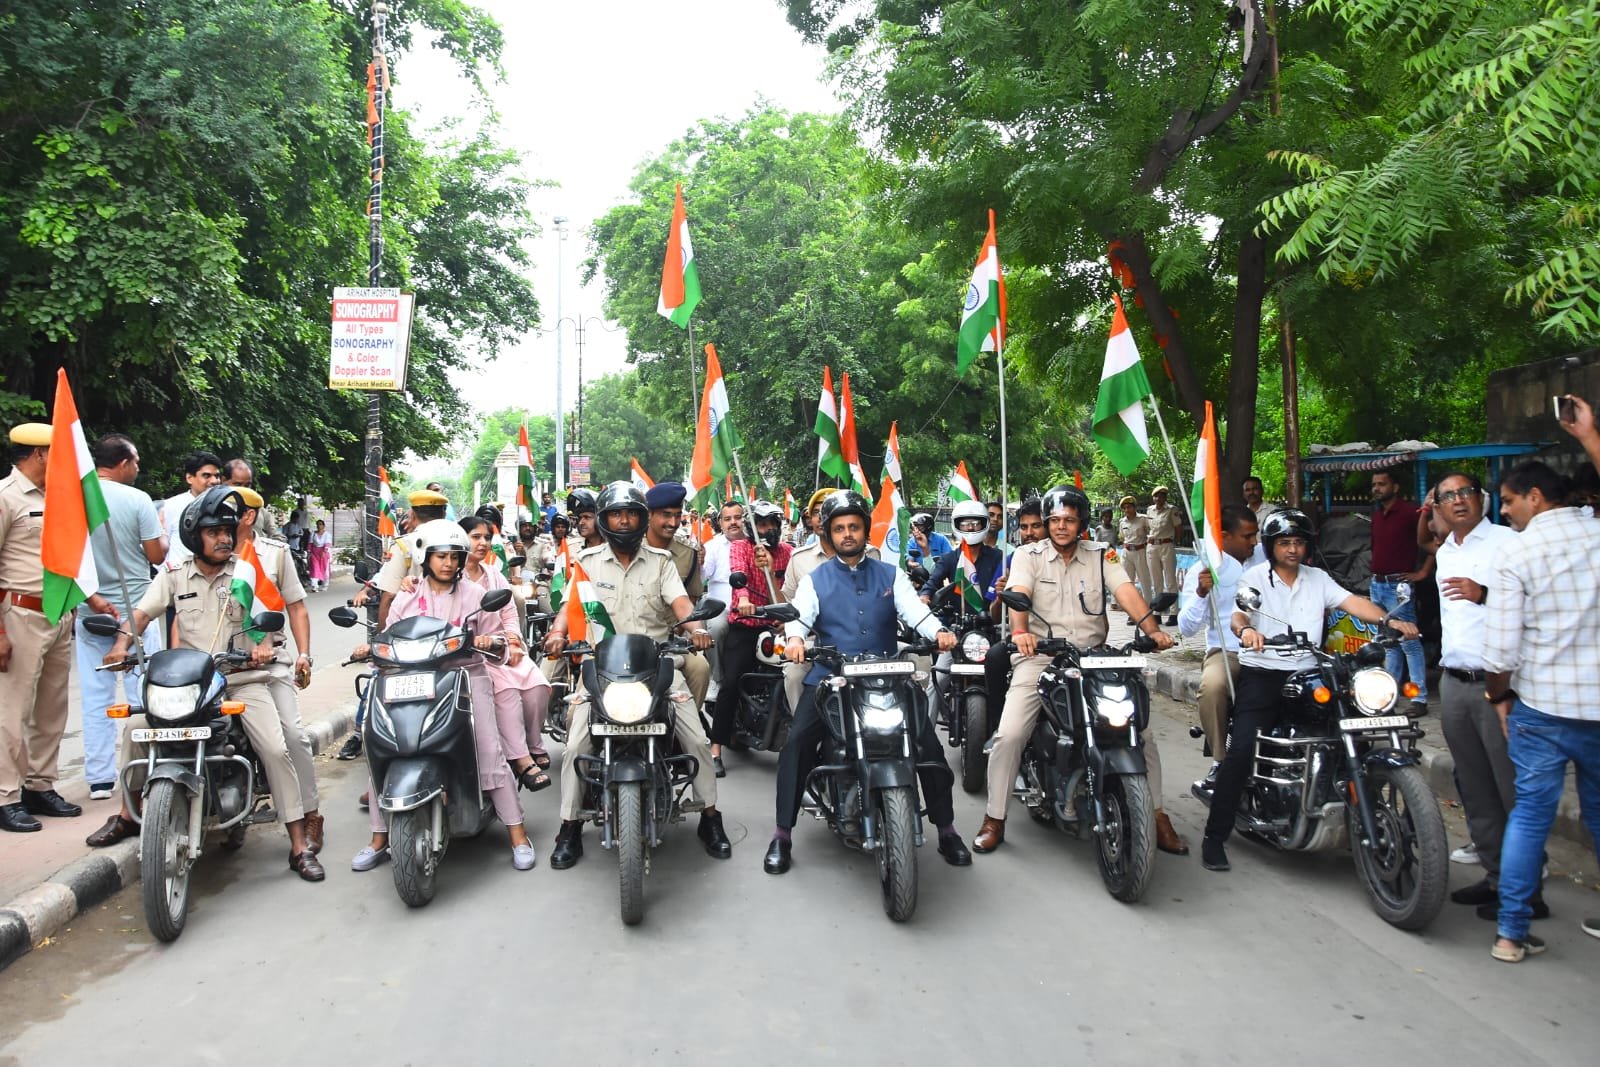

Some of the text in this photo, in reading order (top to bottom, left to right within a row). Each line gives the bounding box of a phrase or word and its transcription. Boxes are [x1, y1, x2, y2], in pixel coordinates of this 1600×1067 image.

[371, 289, 398, 298] HOSPITAL
[335, 302, 397, 319] SONOGRAPHY
[345, 323, 384, 336] All Types
[334, 338, 395, 349] SONOGRAPHY
[347, 352, 379, 363] & Color
[334, 365, 392, 378] Doppler Scan
[347, 380, 369, 388] Arihant
